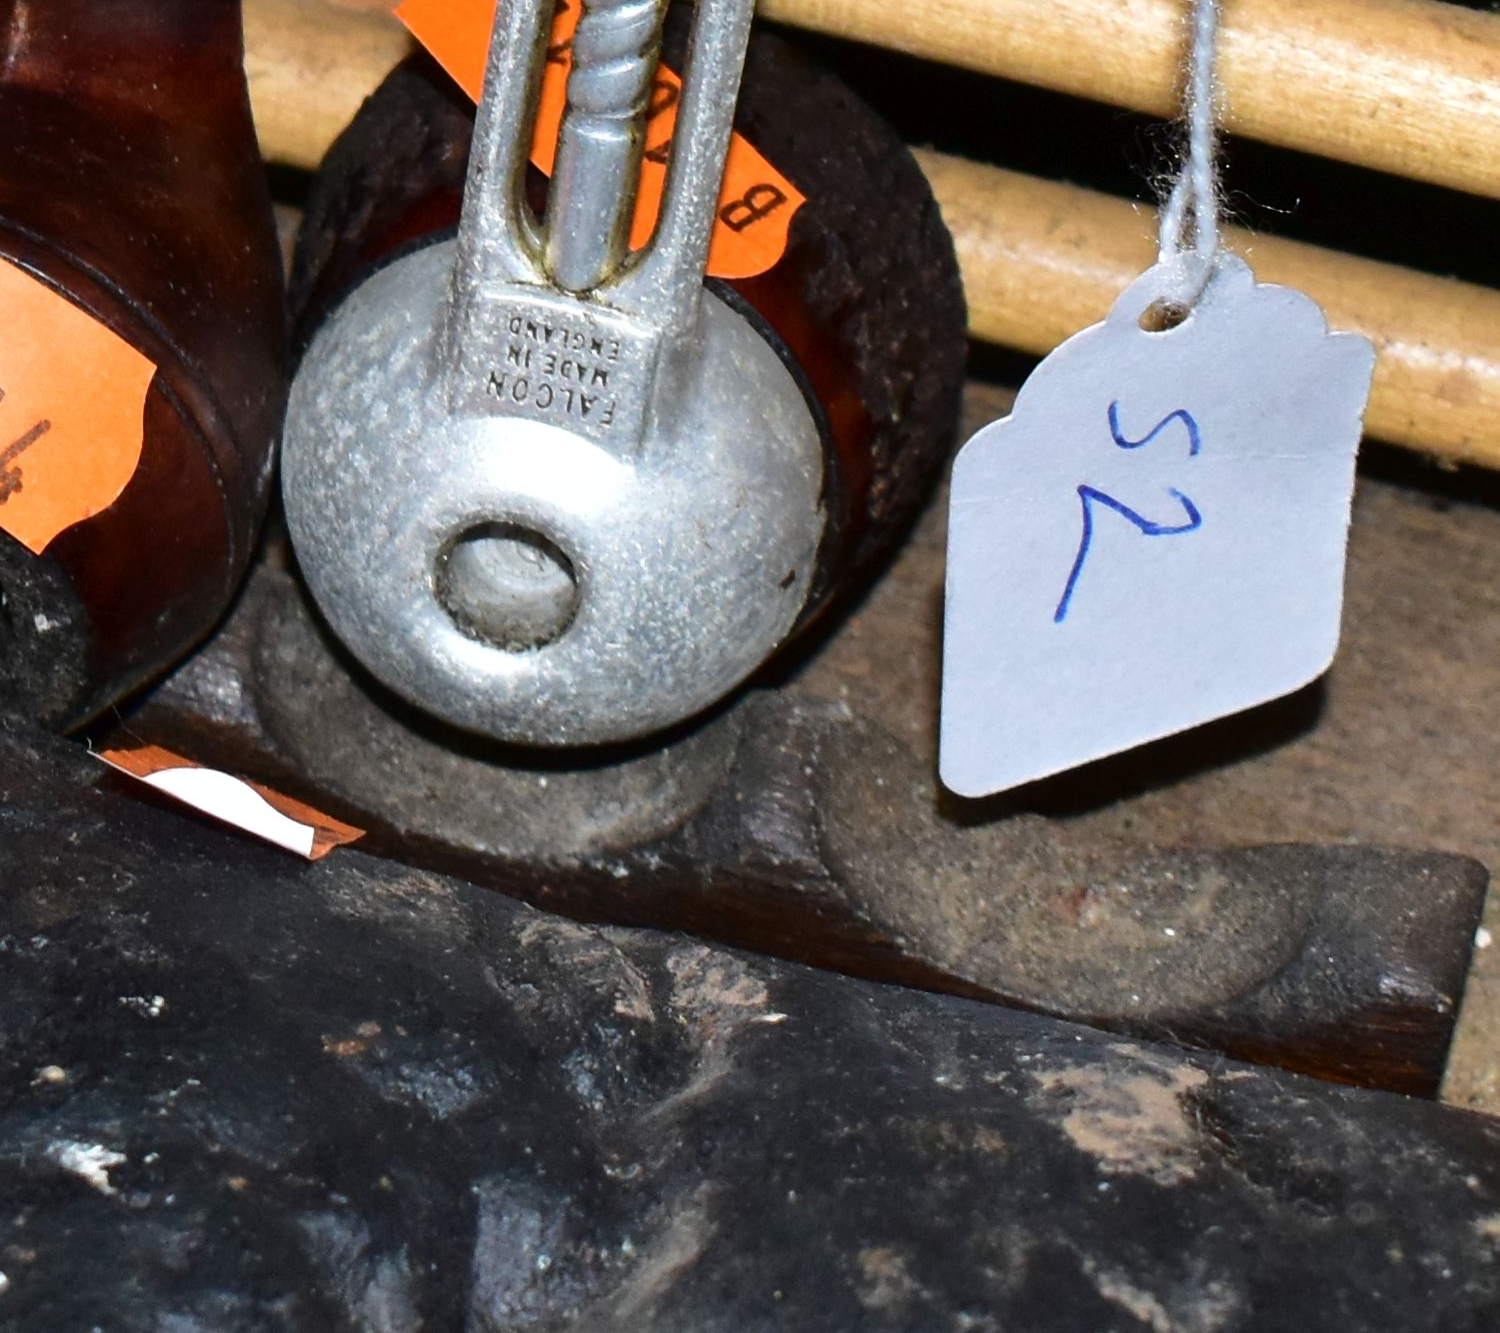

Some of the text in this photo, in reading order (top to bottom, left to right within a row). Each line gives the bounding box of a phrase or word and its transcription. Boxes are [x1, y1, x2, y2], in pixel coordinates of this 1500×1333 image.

[719, 182, 788, 233] B
[508, 316, 621, 364] ENGLAND
[505, 343, 610, 391] MADE IN
[485, 370, 618, 430] FALCON
